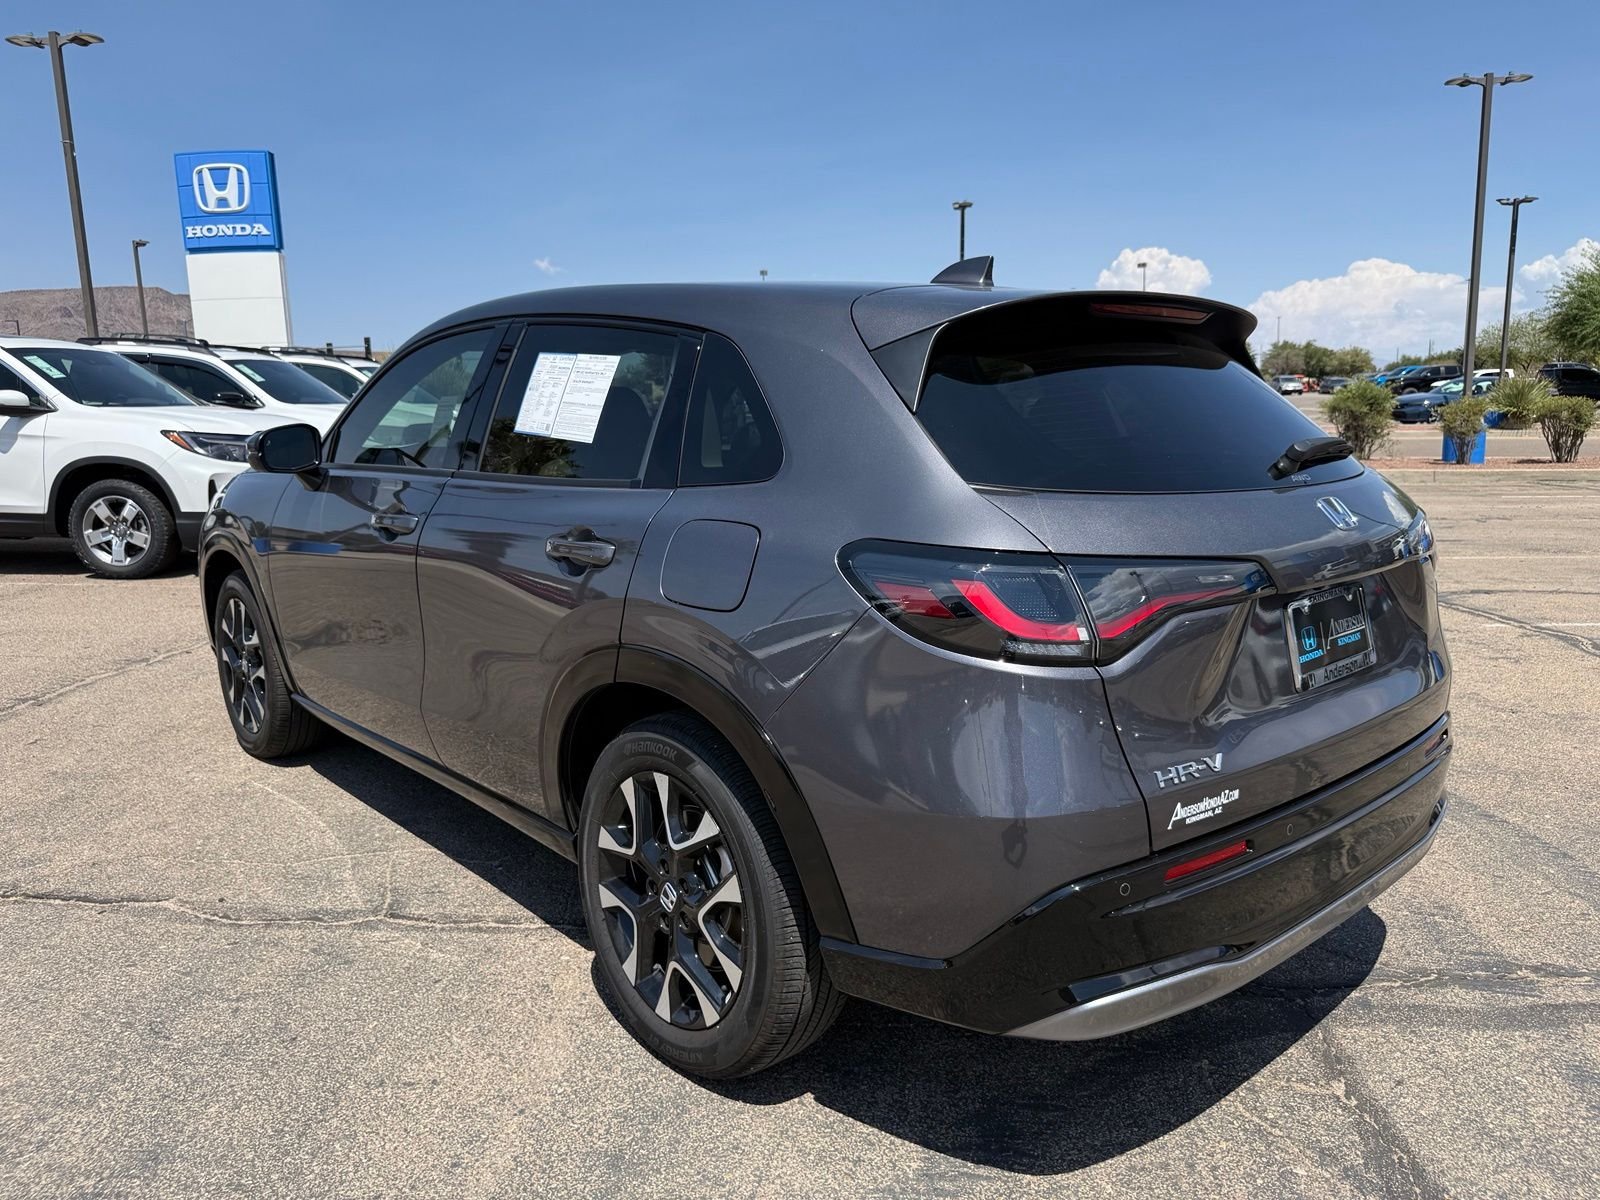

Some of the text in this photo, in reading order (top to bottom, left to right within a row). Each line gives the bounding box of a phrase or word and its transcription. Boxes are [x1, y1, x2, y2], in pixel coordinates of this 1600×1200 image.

[185, 223, 271, 239] HONDA
[1291, 473, 1311, 482] AWD
[1326, 614, 1364, 650] ANDERSON
[1337, 632, 1361, 646] KINGMAN
[1299, 650, 1323, 664] HONDA
[1323, 661, 1358, 681] Anderson
[1154, 752, 1223, 789] HR-V
[1214, 806, 1223, 815] AZ
